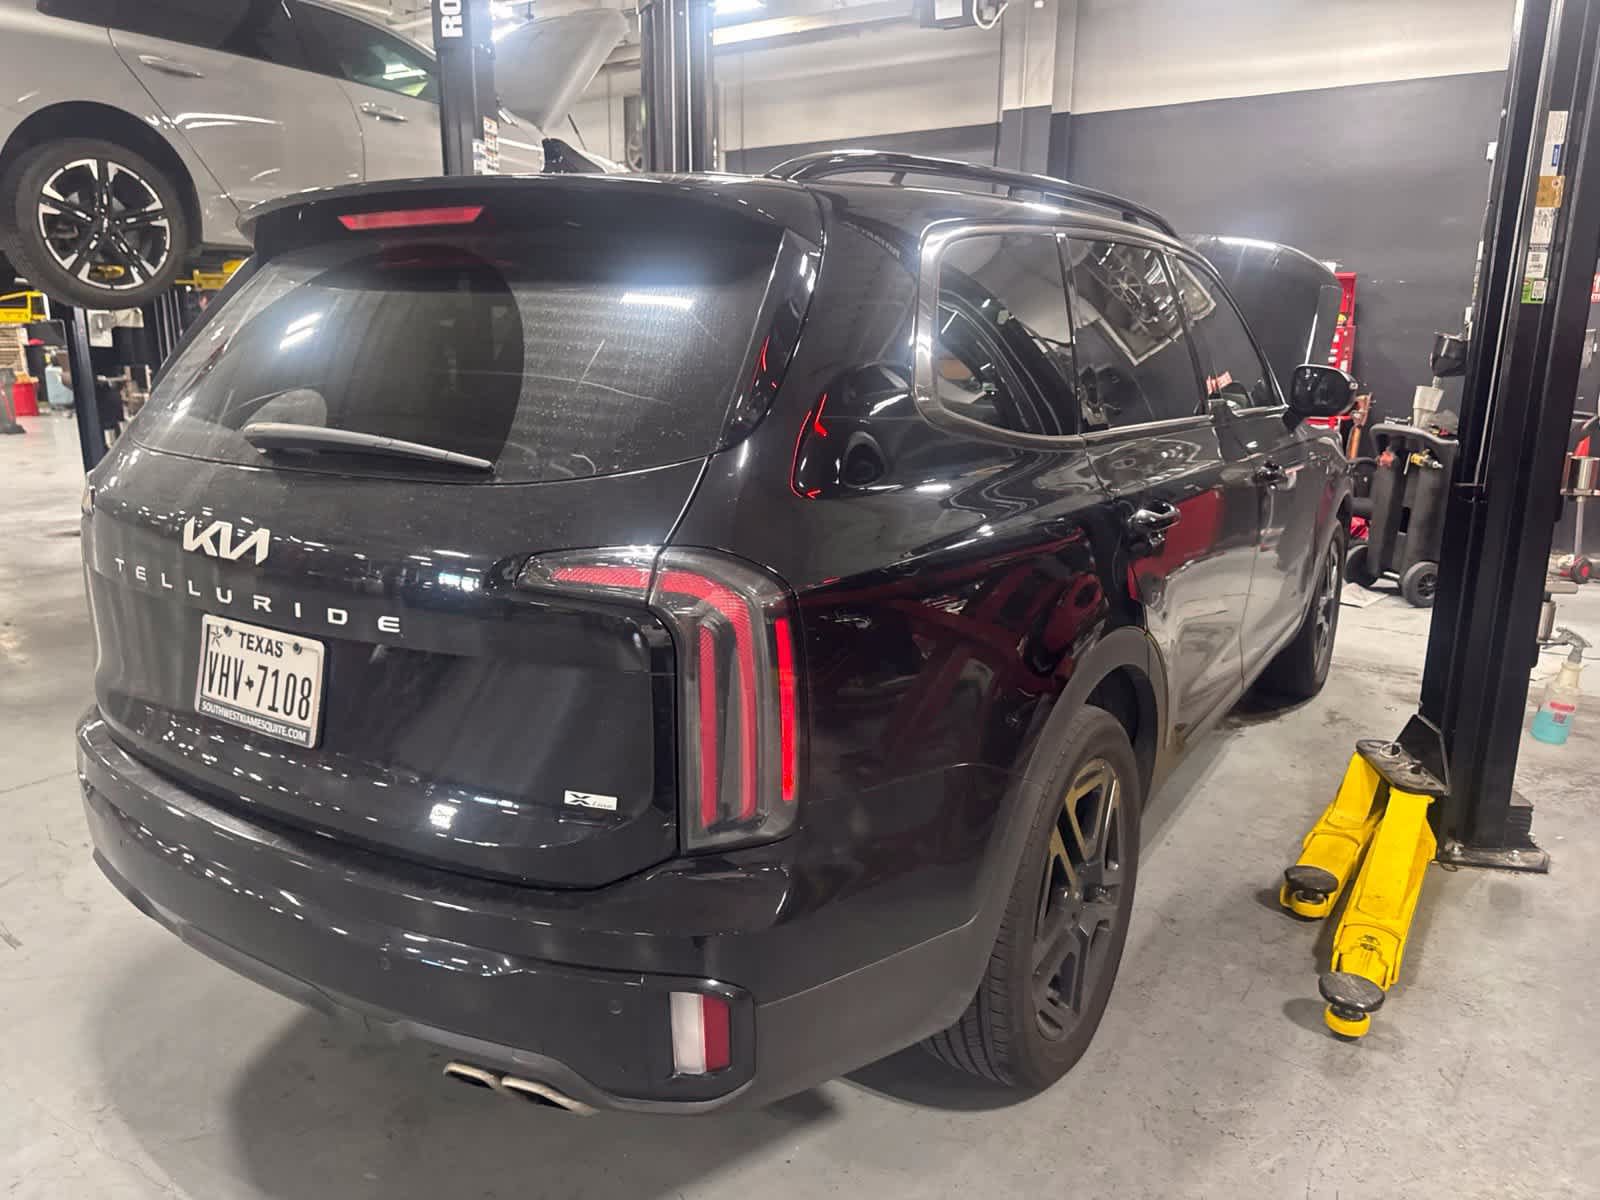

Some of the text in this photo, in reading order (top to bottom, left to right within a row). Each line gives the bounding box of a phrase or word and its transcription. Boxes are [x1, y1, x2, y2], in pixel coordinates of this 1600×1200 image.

[182, 516, 271, 565] KIA
[114, 557, 402, 634] TELLURIDE
[238, 631, 285, 659] TEXAS
[256, 664, 313, 721] 7108
